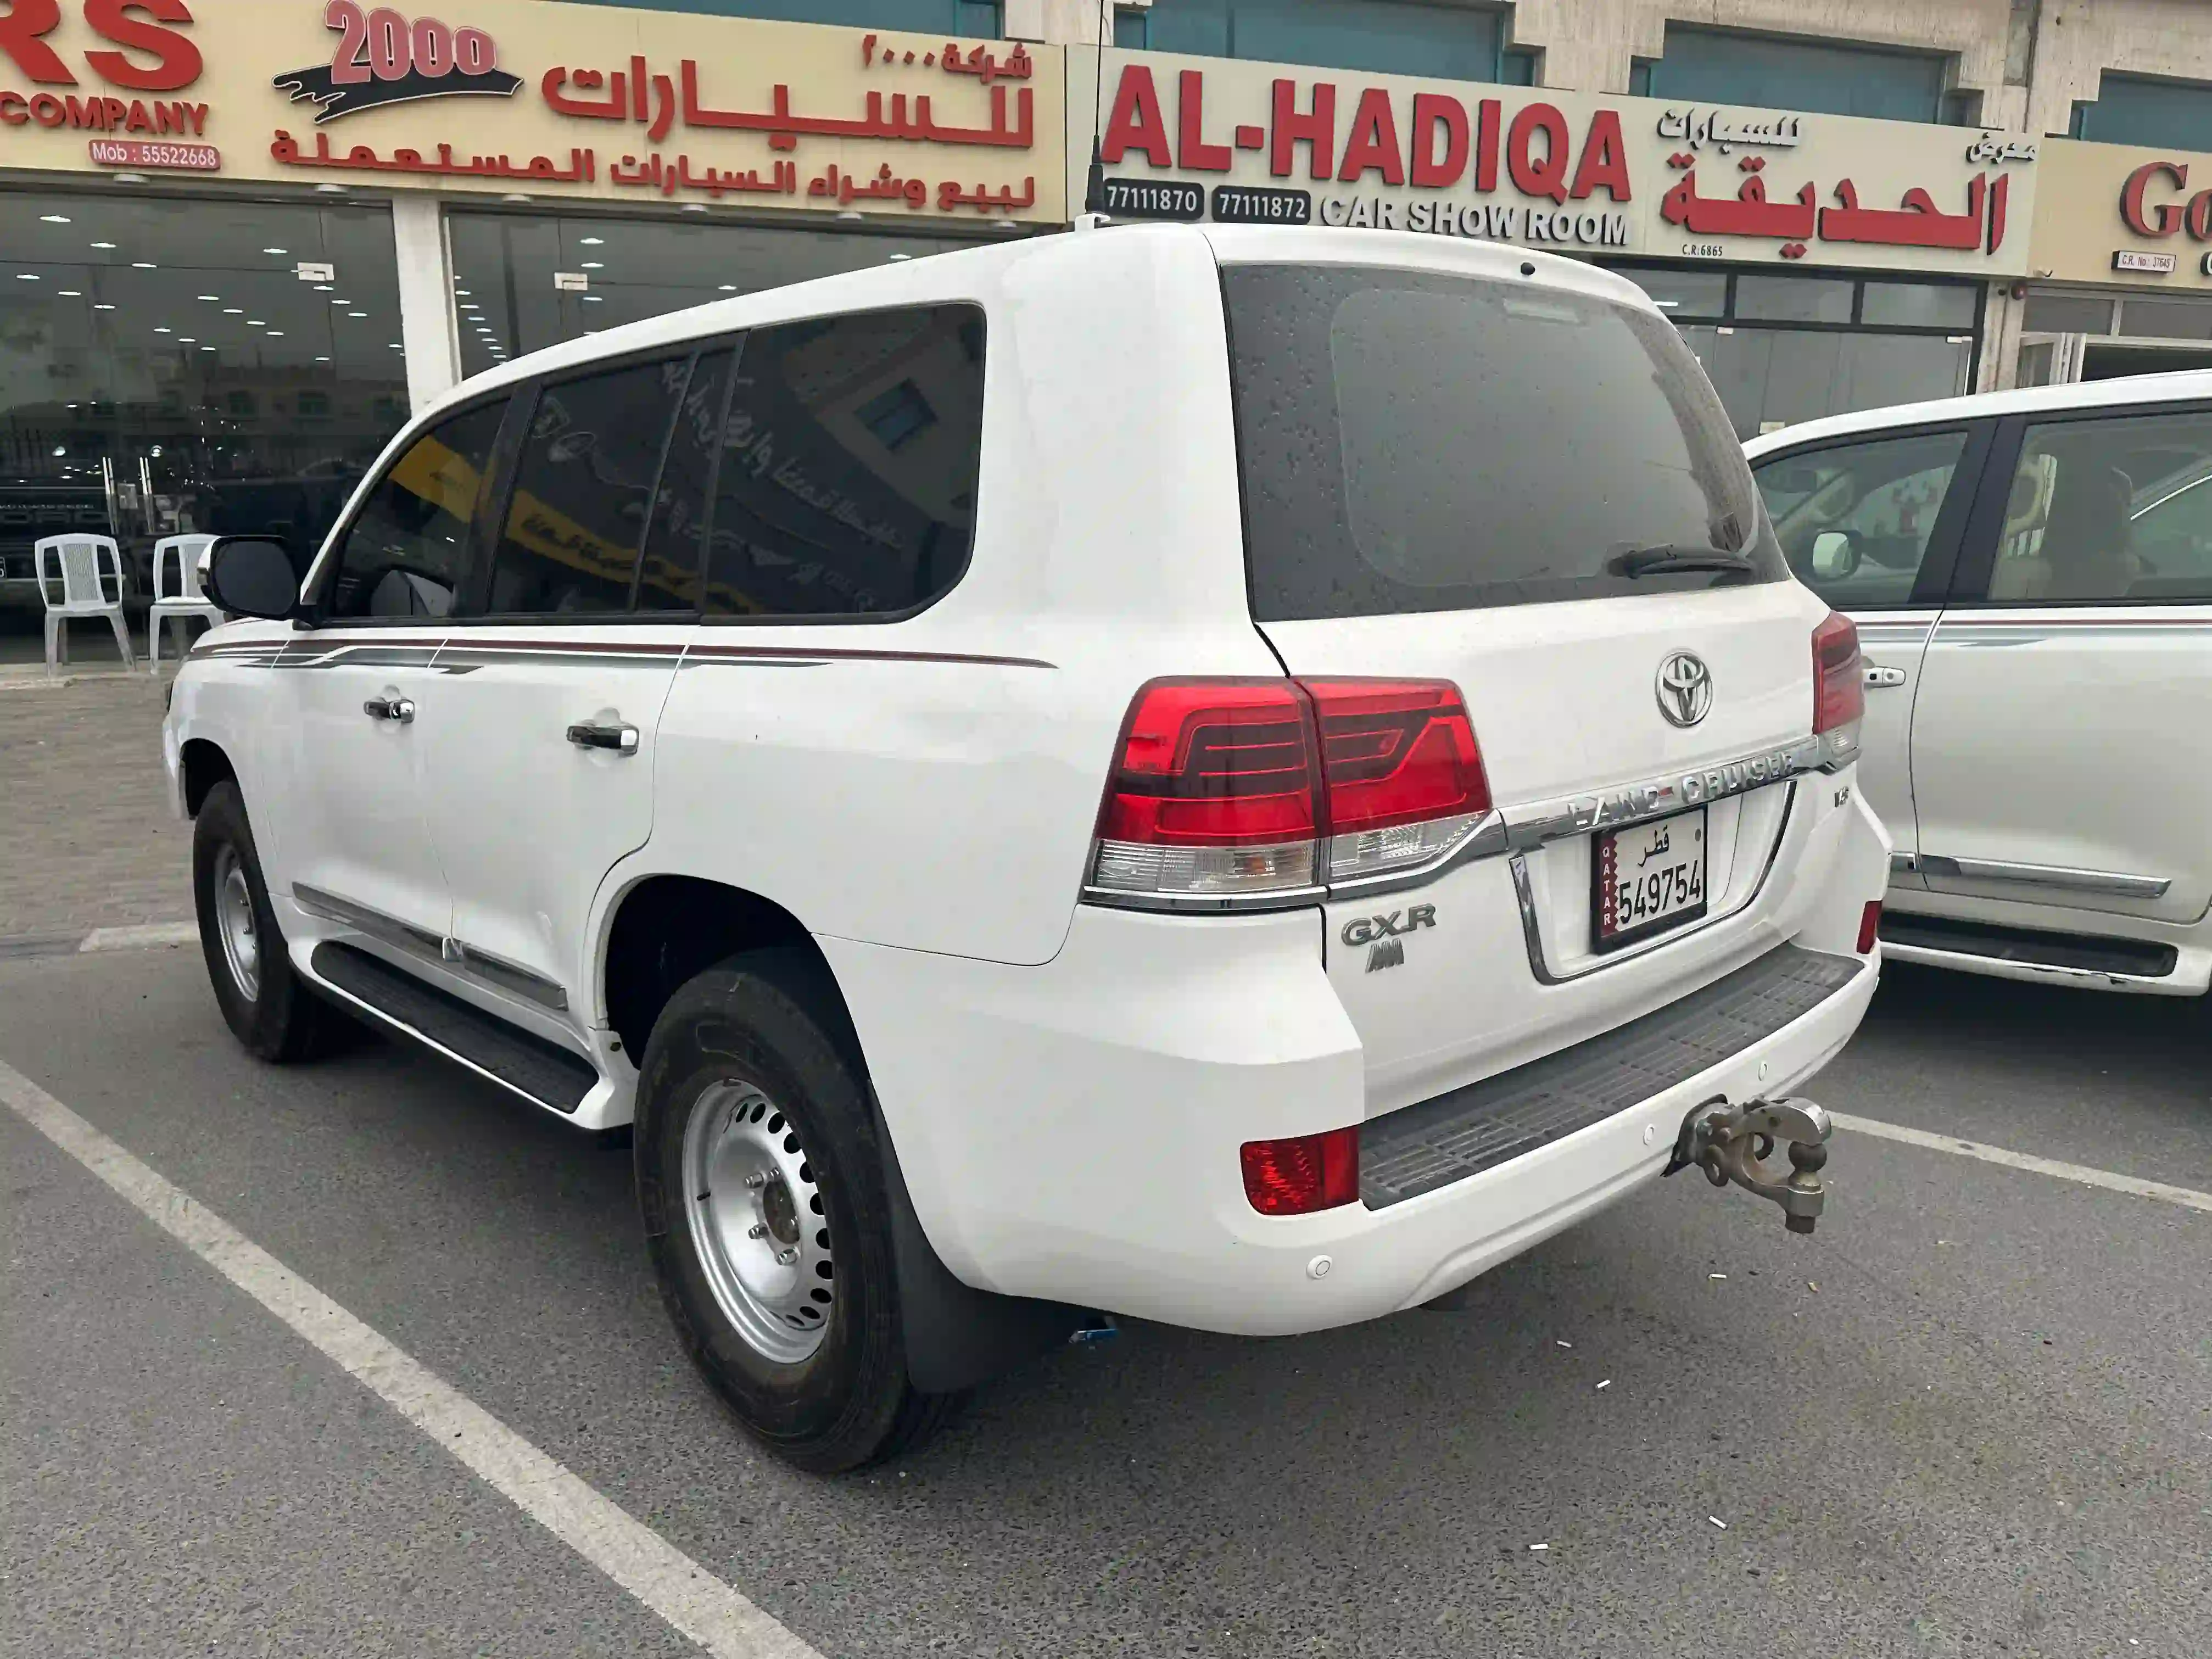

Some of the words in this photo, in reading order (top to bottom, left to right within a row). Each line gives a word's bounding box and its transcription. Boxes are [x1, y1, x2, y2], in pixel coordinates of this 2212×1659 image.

[325, 0, 496, 84] 2000
[941, 42, 1032, 84] شركة
[0, 91, 209, 136] COMPANY
[541, 55, 1033, 152] للسيارات
[1100, 64, 1632, 205] AL-HADIQA
[1657, 107, 1801, 154] للسيارات
[1966, 132, 2037, 164] معرض
[142, 146, 216, 166] 55522668
[271, 130, 596, 184] المستعملة
[610, 154, 796, 199] السيارات
[807, 163, 926, 209] وشراء
[937, 176, 1035, 214] لبيع
[1107, 185, 1197, 212] 77111870
[1220, 193, 1305, 219] 77111872
[1661, 152, 2009, 259] الحديقة
[1320, 195, 1403, 228] CAR
[1408, 200, 1523, 239] SHOW
[1526, 211, 1629, 246] ROOM
[1567, 785, 1660, 826] LAND
[1681, 751, 1794, 806] CRUISER
[1637, 825, 1669, 867] قطر
[1602, 846, 1611, 925] QATAR
[1619, 859, 1701, 924] 549754
[1341, 903, 1437, 946] GXR
